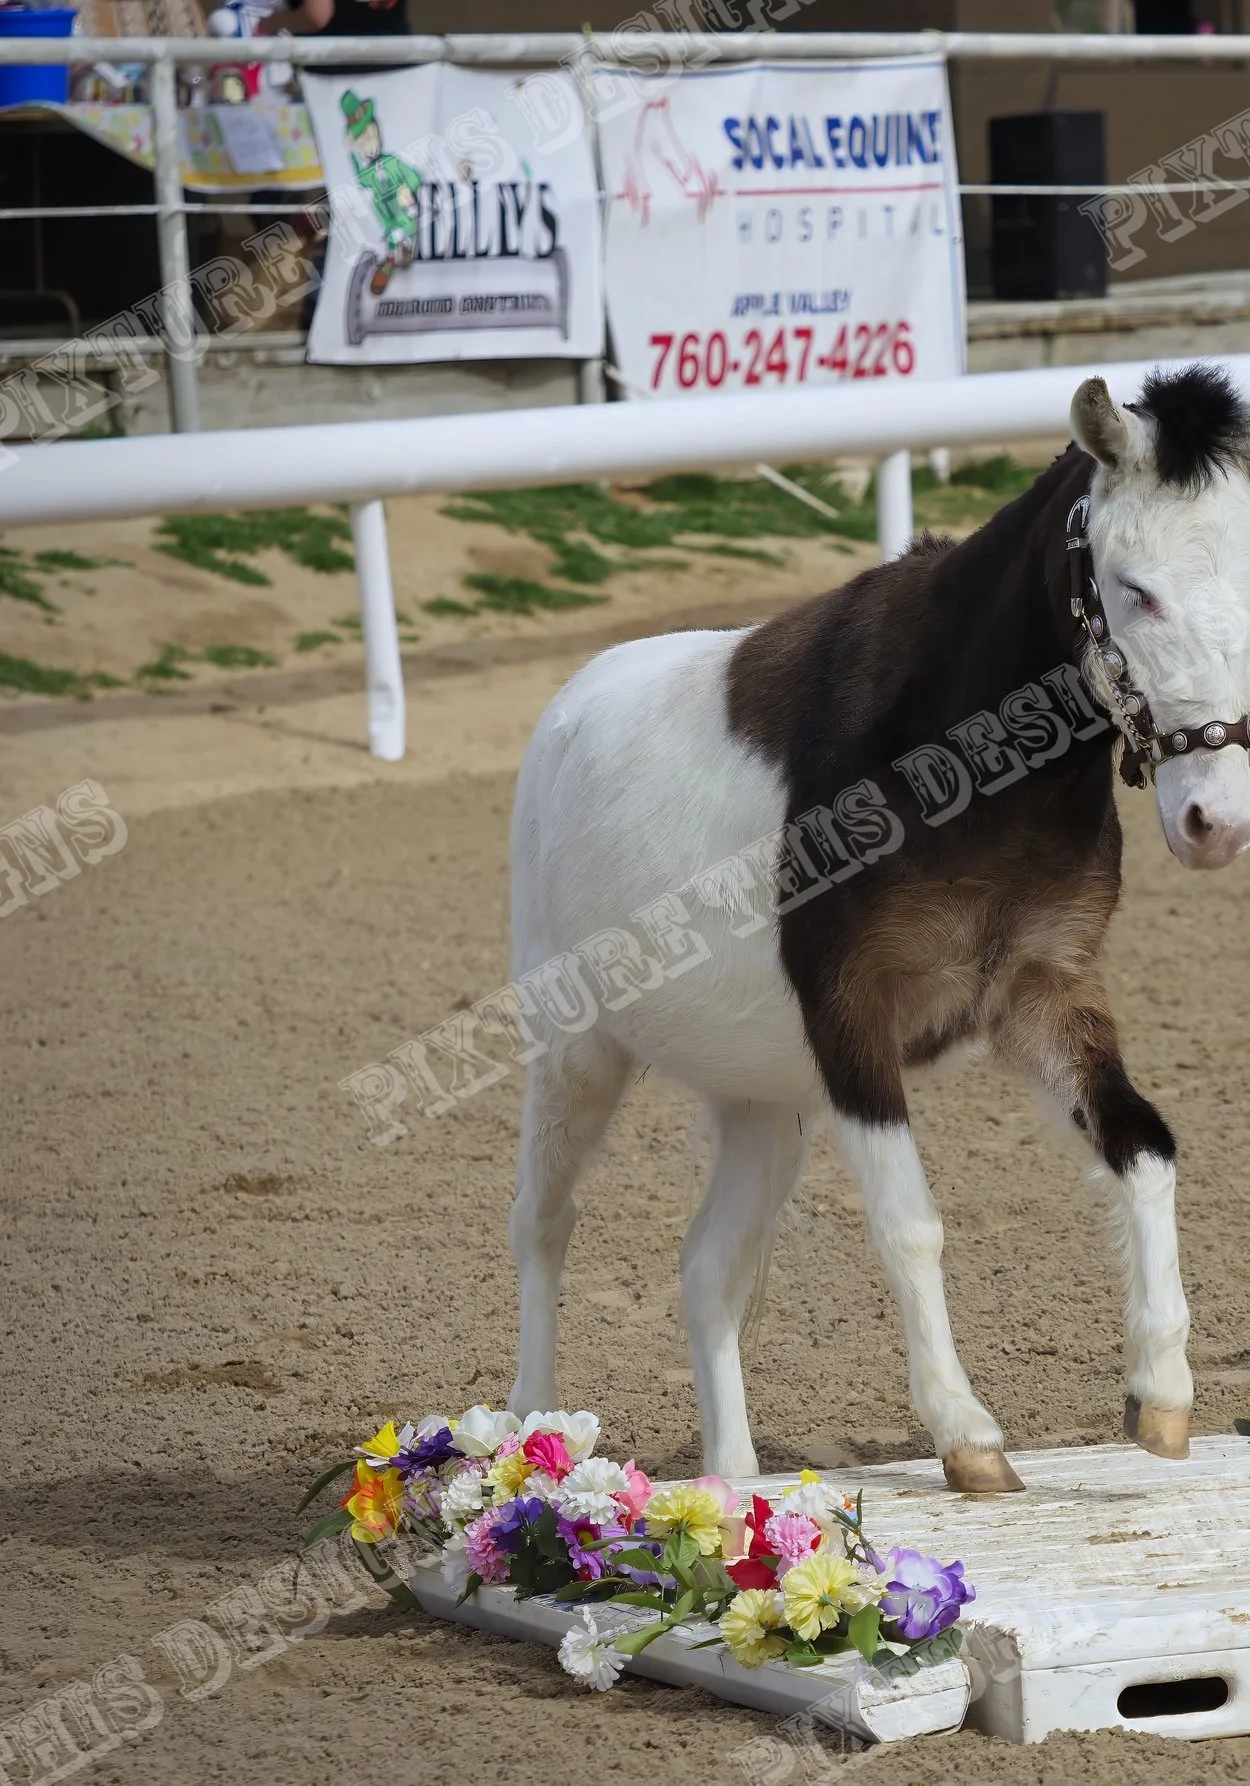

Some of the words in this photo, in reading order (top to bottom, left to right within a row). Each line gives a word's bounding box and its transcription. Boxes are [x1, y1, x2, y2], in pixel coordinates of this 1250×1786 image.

[722, 114, 824, 170] SOCAL
[826, 108, 941, 168] EQUINE
[413, 170, 558, 261] ELLY'S
[735, 205, 945, 246] HOSPITAL
[649, 321, 915, 391] 760-247-4226
